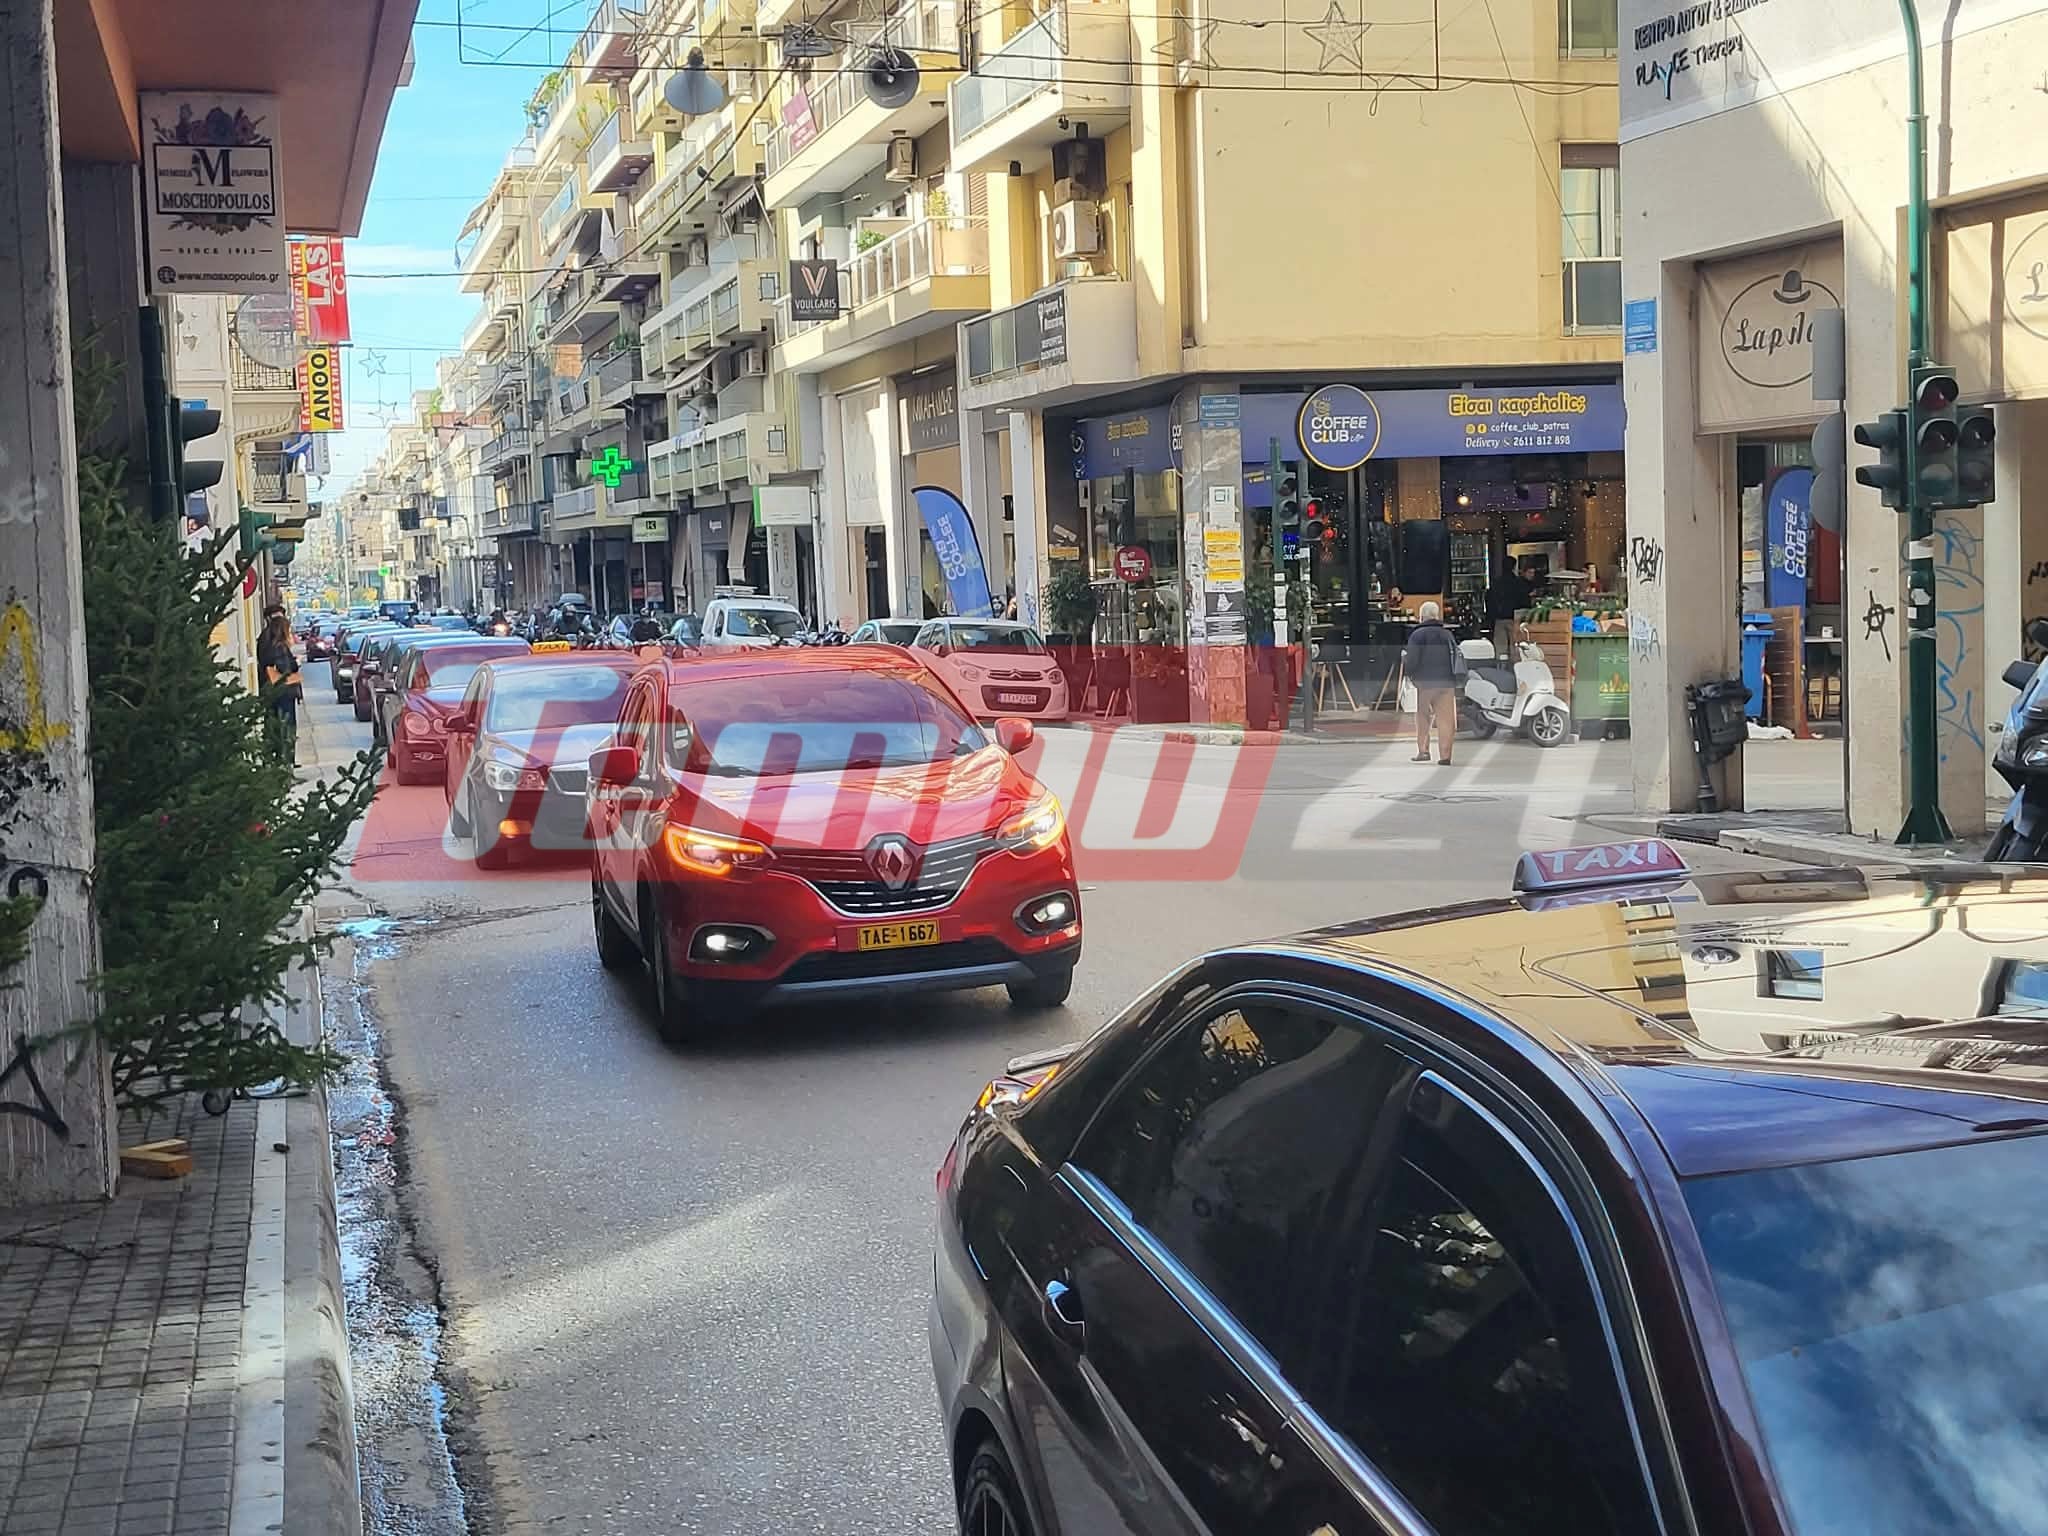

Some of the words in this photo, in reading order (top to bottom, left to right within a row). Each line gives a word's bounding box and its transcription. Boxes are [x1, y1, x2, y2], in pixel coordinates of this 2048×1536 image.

[162, 192, 271, 210] MOSCHOPOULOS
[178, 247, 219, 255] SINCE
[306, 236, 331, 306] LAS
[795, 298, 837, 309] VOULGARIS
[1449, 394, 1493, 416] Είσαι
[1311, 416, 1368, 430] COFFEE
[1311, 429, 1349, 443] CLUB
[1465, 437, 1500, 449] Delivery
[1513, 437, 1534, 447] 2611
[1784, 500, 1798, 575] COFFEE
[1795, 529, 1807, 578] CLUB
[536, 643, 567, 651] TAXI
[1541, 841, 1658, 874] TAXI
